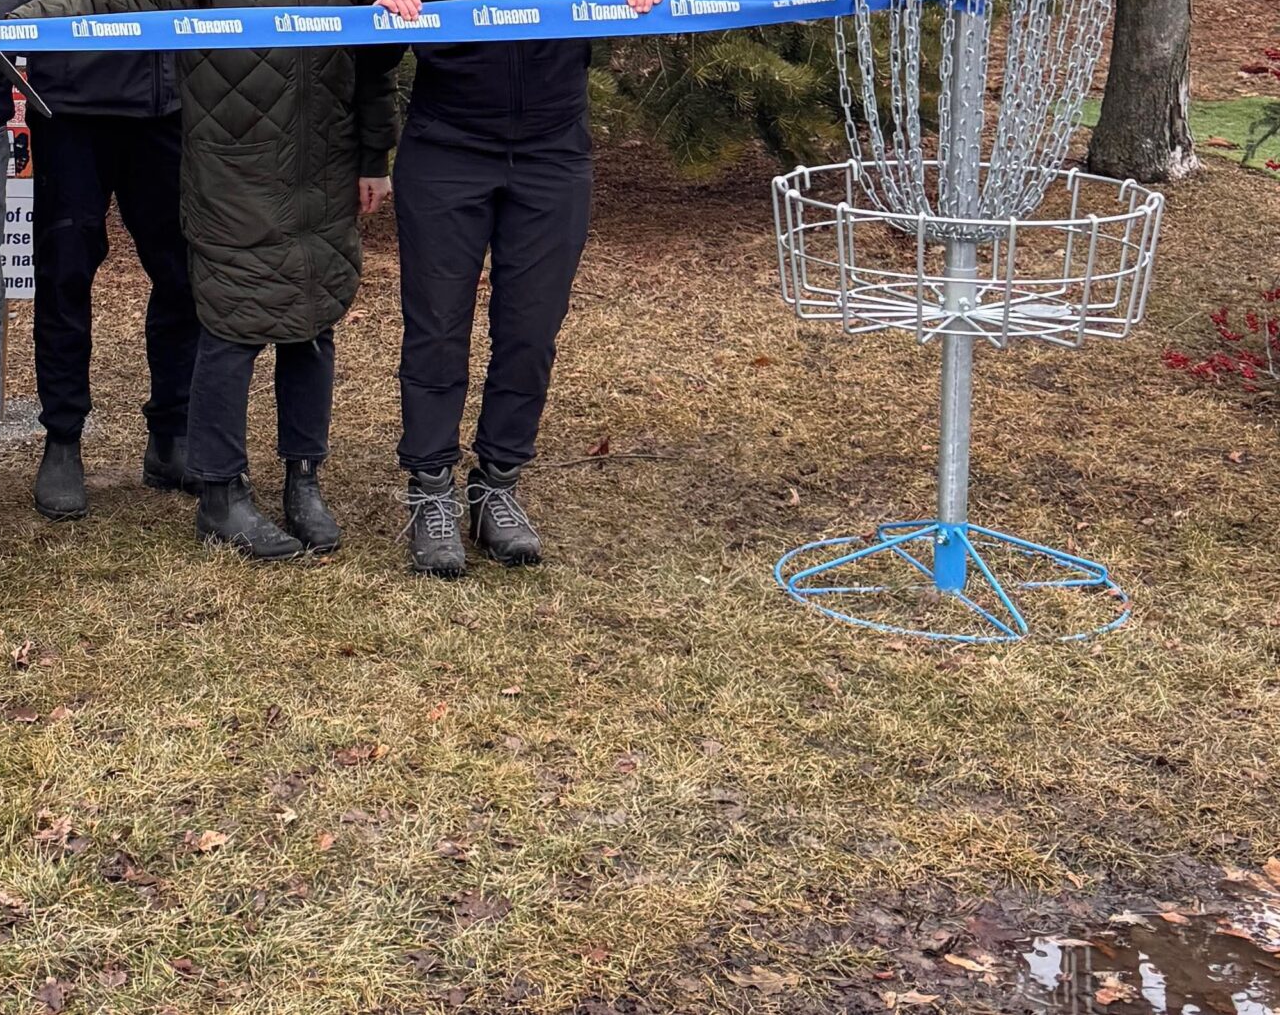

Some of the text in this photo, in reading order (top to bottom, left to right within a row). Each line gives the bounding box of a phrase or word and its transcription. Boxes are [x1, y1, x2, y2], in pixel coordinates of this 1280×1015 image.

[291, 14, 342, 32] TORONTO
[489, 6, 540, 25] TORONTO
[89, 20, 141, 37] TORONTO
[191, 17, 243, 34] TORONTO
[6, 207, 22, 223] of
[12, 254, 34, 267] na
[4, 276, 33, 288] men
